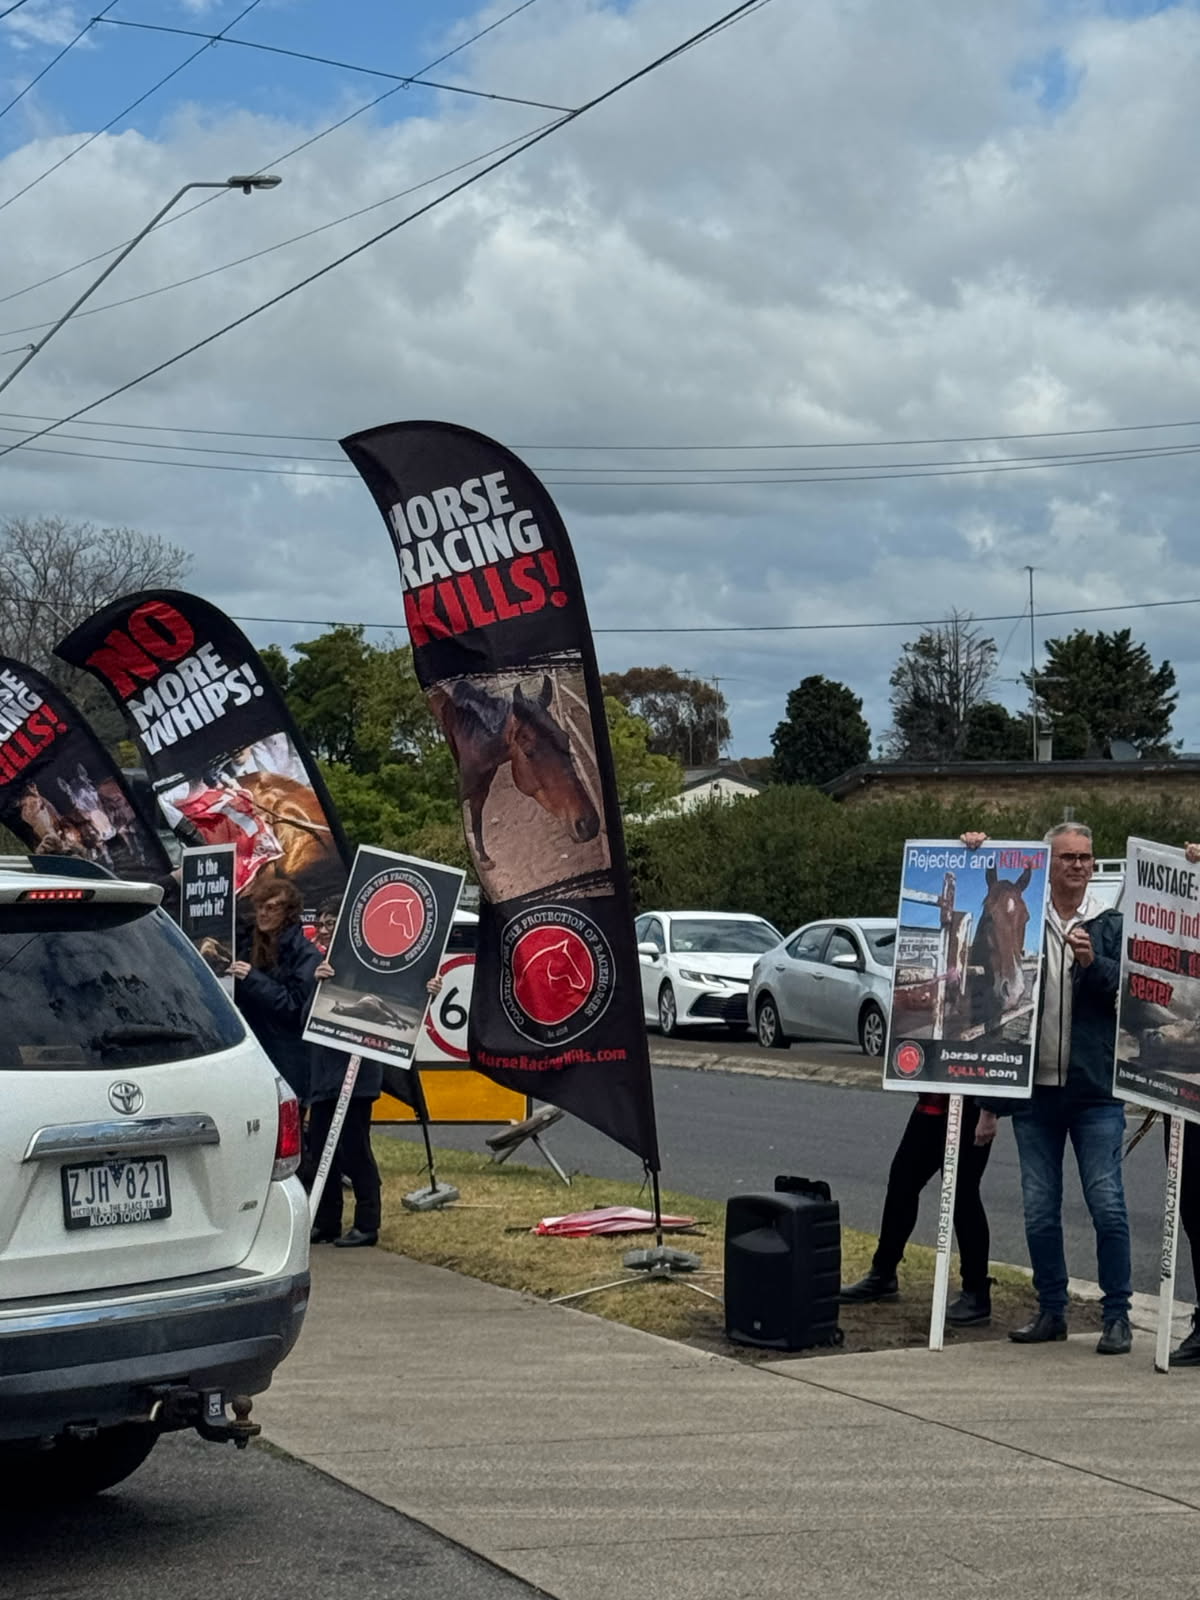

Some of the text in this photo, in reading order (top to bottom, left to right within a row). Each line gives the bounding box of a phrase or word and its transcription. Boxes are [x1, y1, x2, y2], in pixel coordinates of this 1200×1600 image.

[388, 471, 515, 545] HORSE
[399, 509, 544, 591] RACING
[403, 550, 568, 648] KILLS!
[85, 600, 194, 699] NO
[126, 641, 229, 731] MORE
[140, 662, 264, 755] WHIPS!
[205, 858, 219, 875] the
[908, 850, 967, 872] Rejected
[969, 851, 996, 869] and
[1136, 859, 1199, 901] WASTAGE:
[186, 876, 229, 899] party really
[189, 898, 213, 917] worth
[521, 911, 586, 931] PROTECTION
[1134, 901, 1200, 940] racing ind
[940, 1049, 1024, 1065] horse racing
[69, 1164, 162, 1207] ZJH 821
